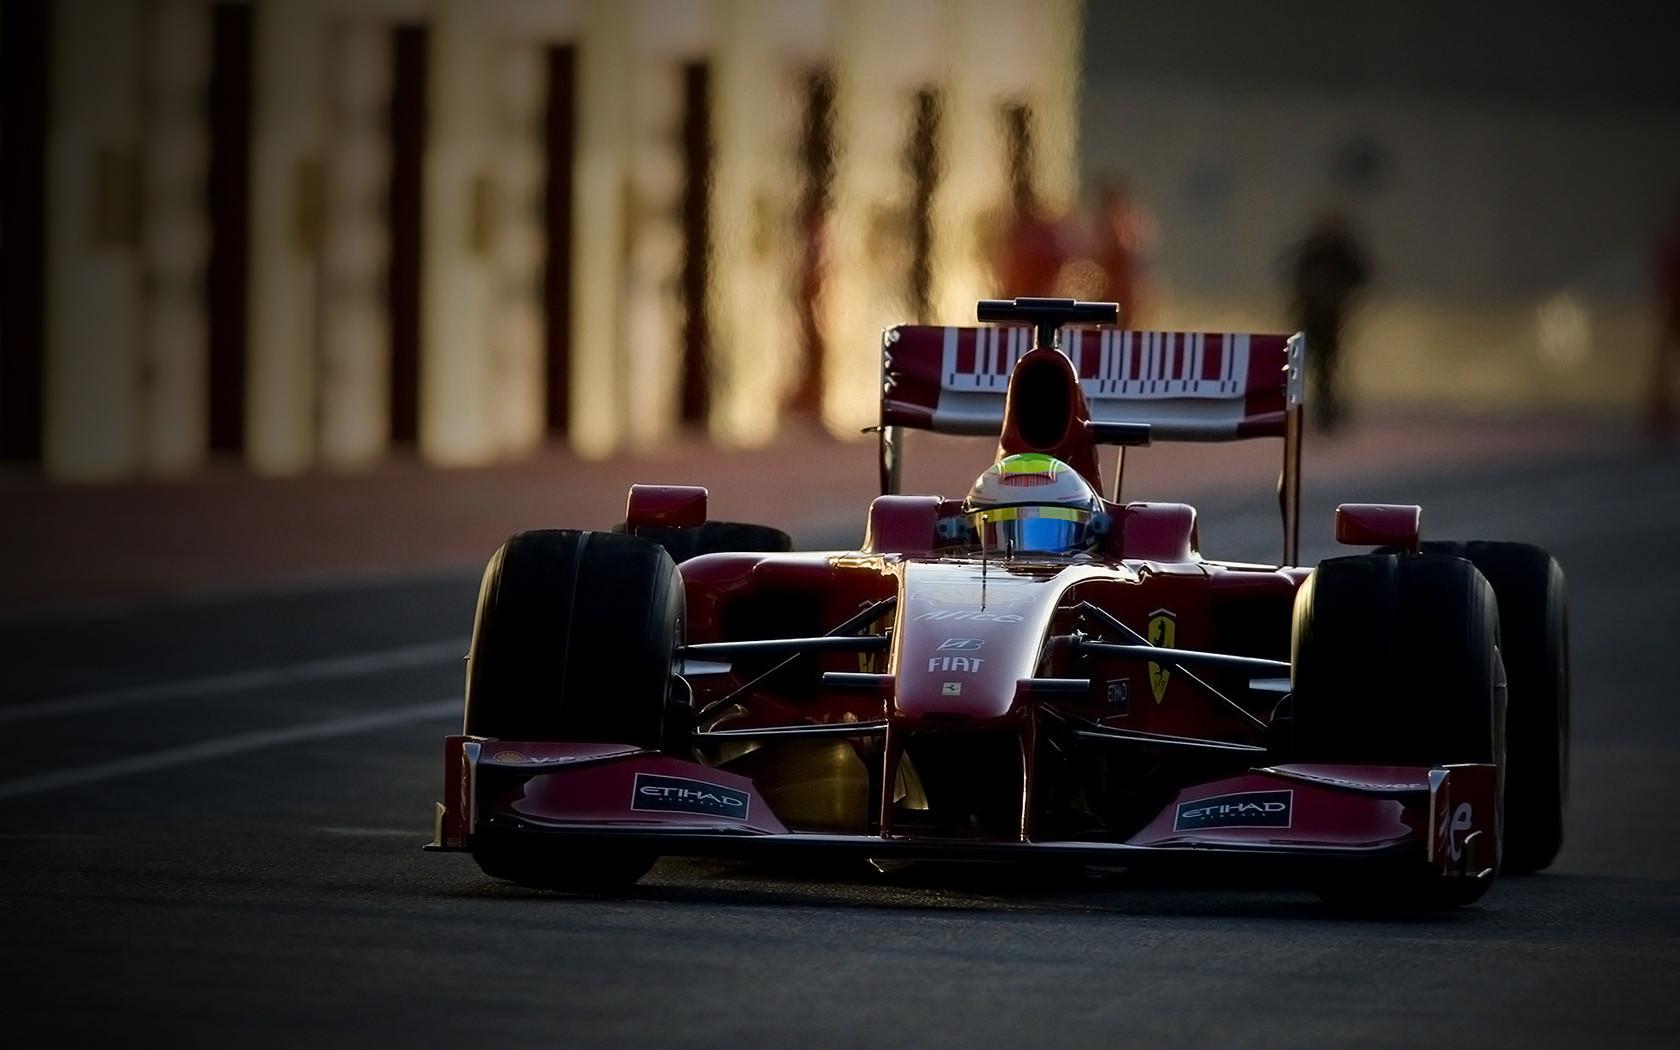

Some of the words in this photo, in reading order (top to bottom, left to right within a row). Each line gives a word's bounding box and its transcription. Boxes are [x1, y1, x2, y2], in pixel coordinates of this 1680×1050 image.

[912, 610, 1025, 623] Alice
[928, 656, 985, 673] FIAT
[639, 786, 743, 807] ETIHAD
[1182, 802, 1287, 819] ETIHAD
